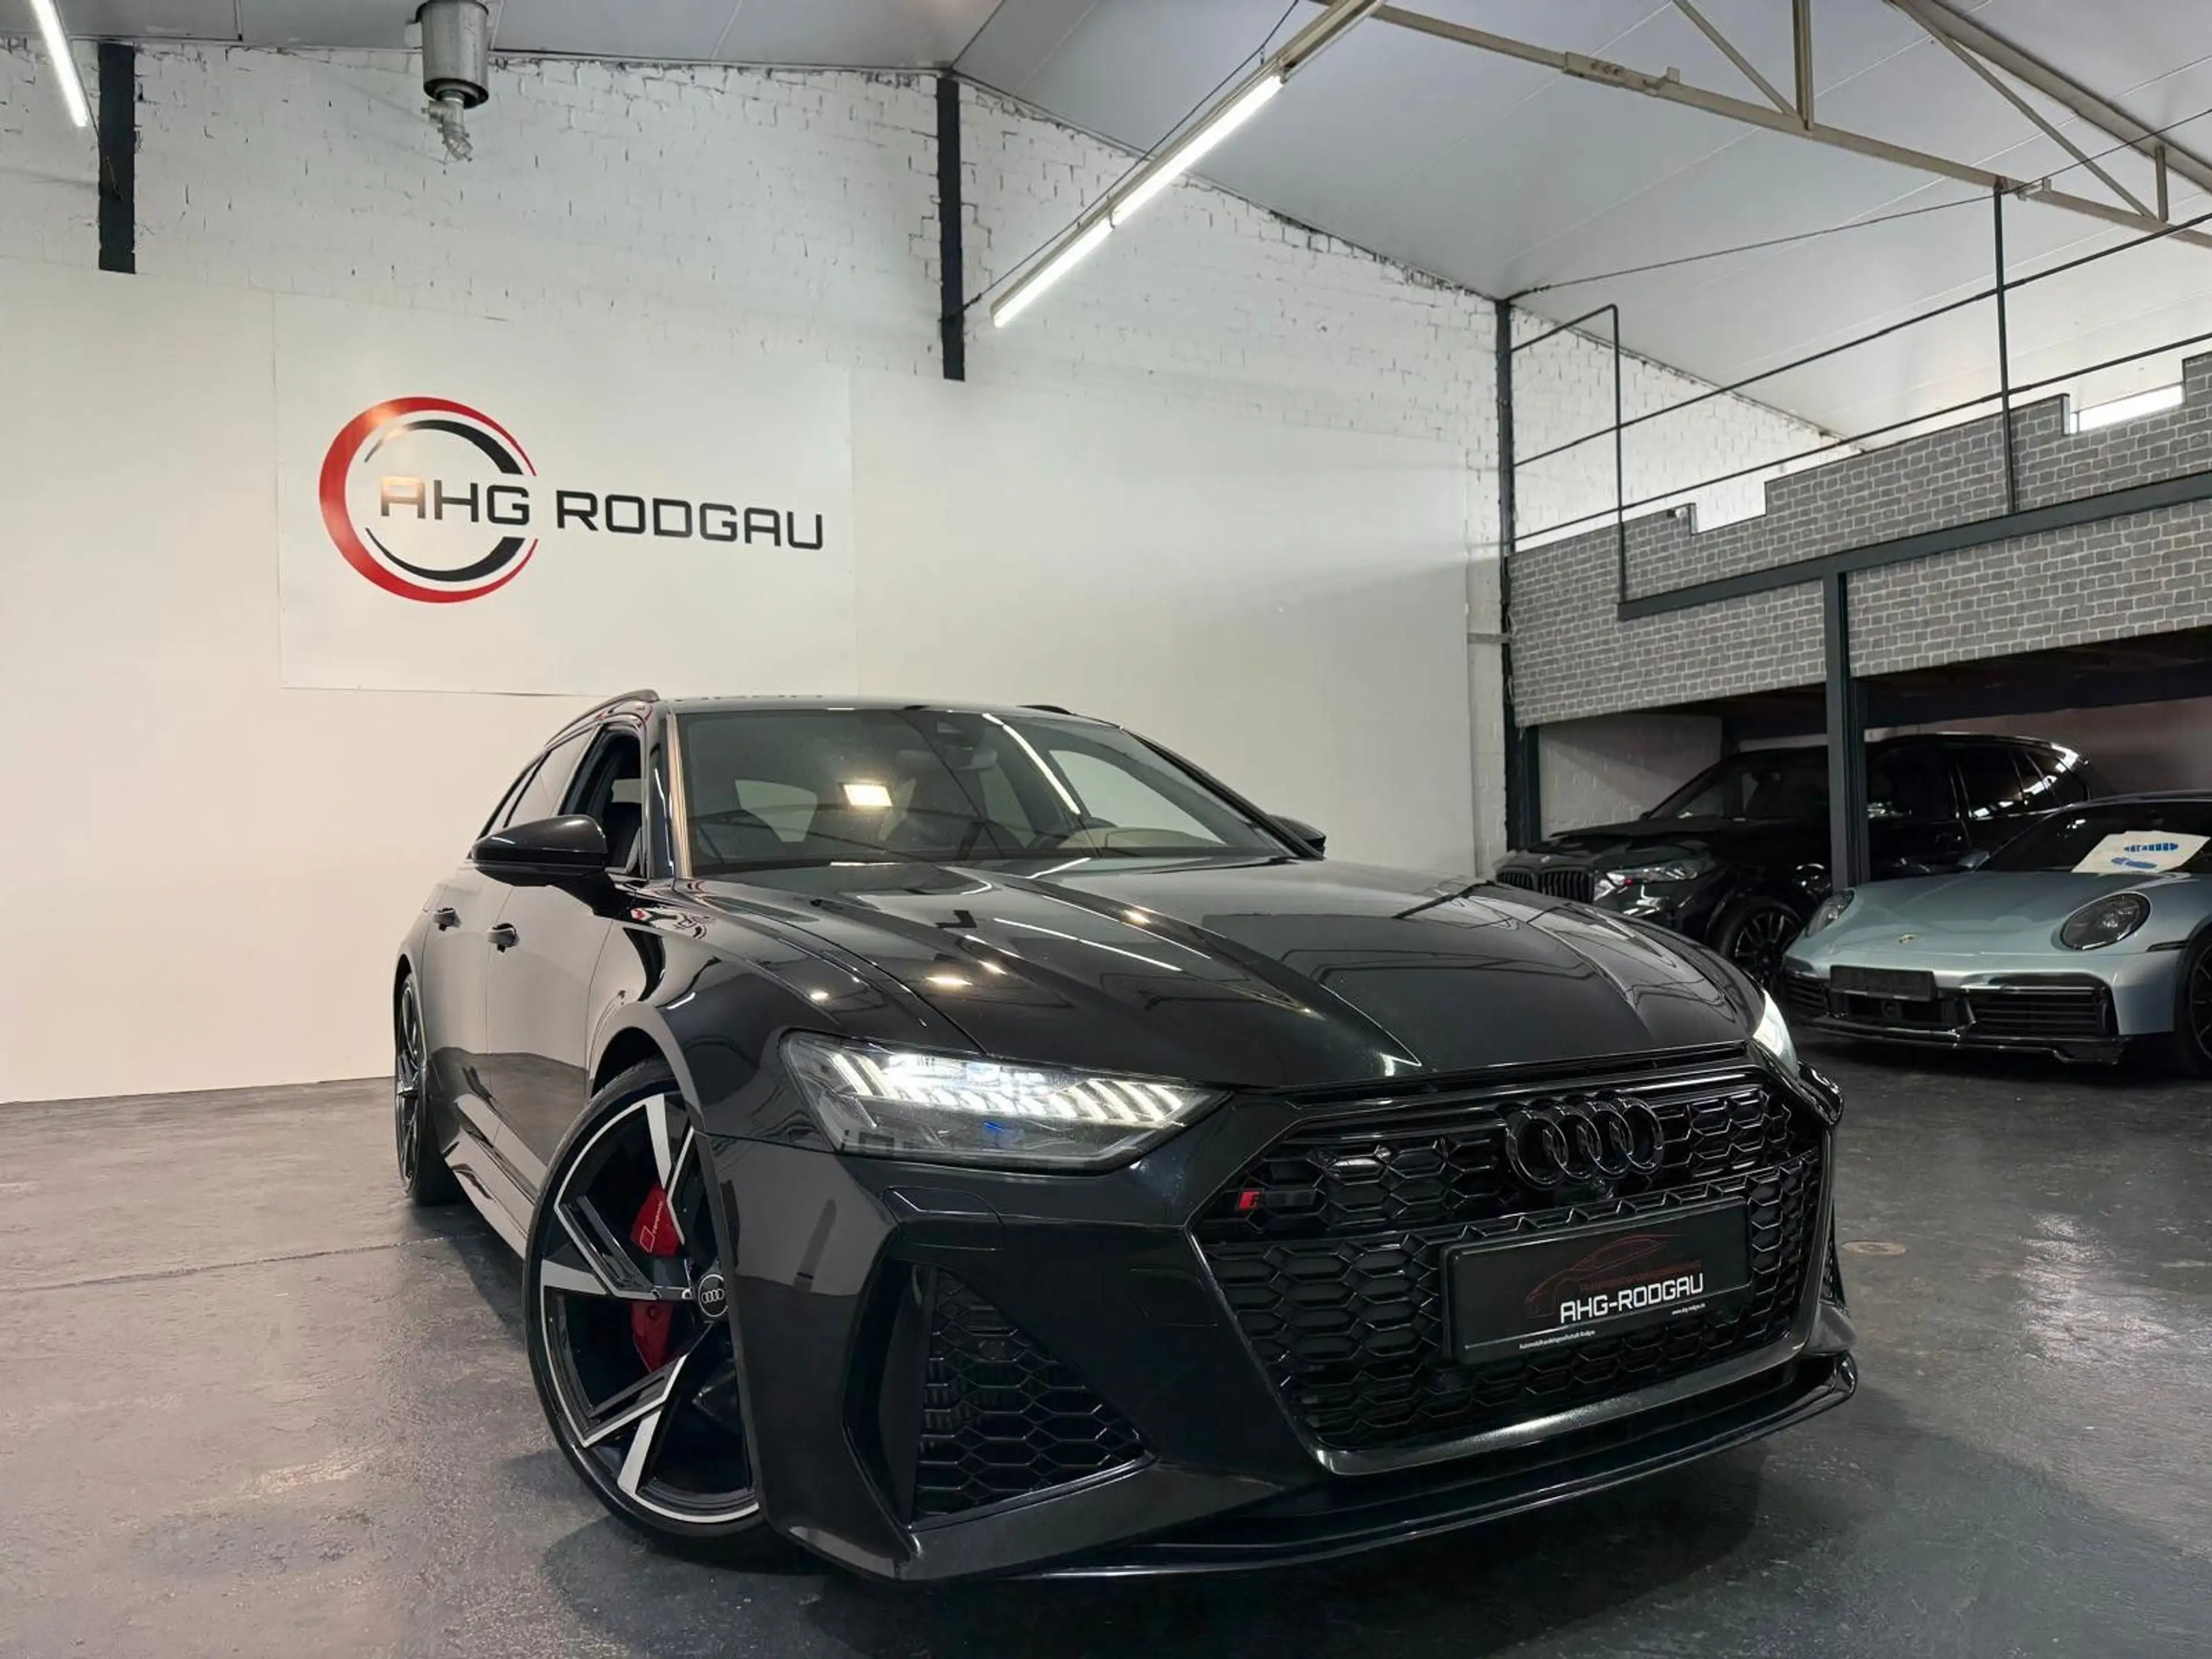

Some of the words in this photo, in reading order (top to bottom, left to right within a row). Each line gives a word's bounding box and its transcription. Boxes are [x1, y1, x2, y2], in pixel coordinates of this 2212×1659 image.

[380, 476, 529, 526] AHG
[556, 490, 823, 550] RODGAU
[1560, 1272, 1704, 1324] AHG-RODGAU
